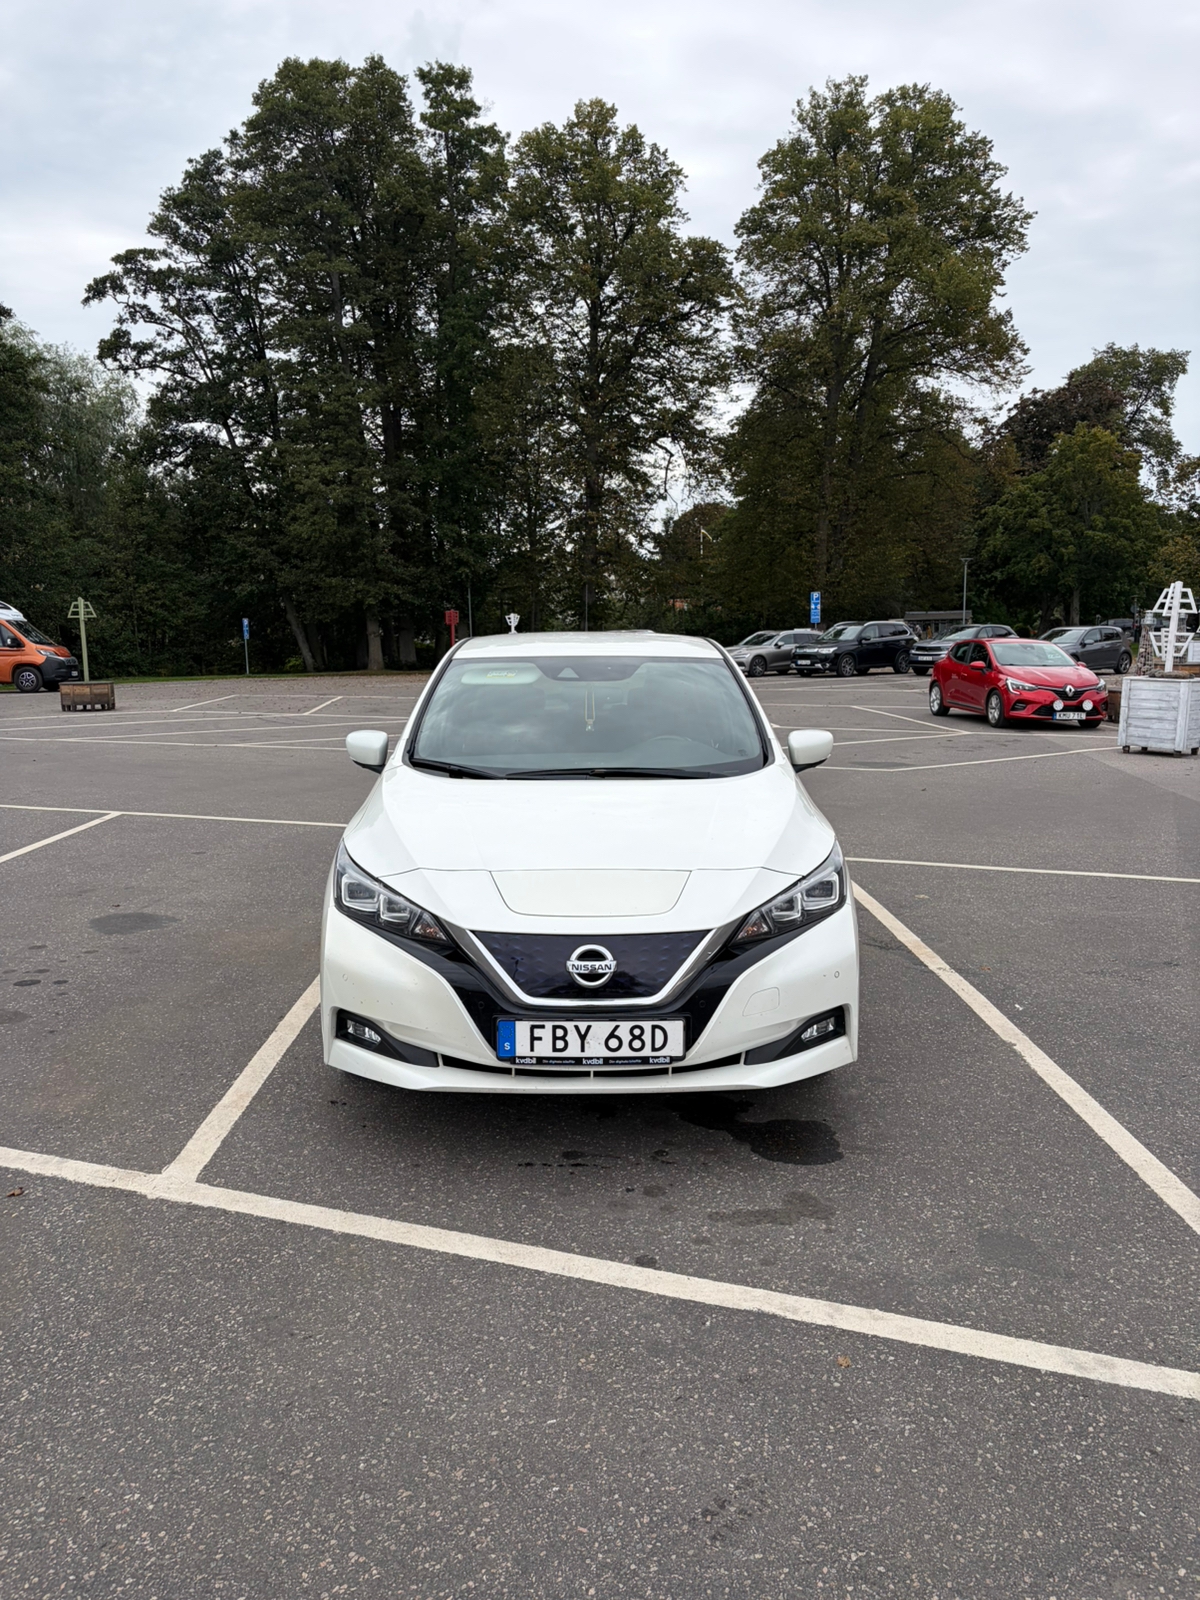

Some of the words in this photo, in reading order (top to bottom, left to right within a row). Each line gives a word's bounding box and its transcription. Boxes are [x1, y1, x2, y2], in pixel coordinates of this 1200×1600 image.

[813, 592, 819, 601] P
[571, 963, 612, 971] NISSAN
[529, 1024, 593, 1053] FBY
[604, 1024, 669, 1053] 68D
[503, 1042, 511, 1051] S
[649, 1056, 671, 1064] kvdbil
